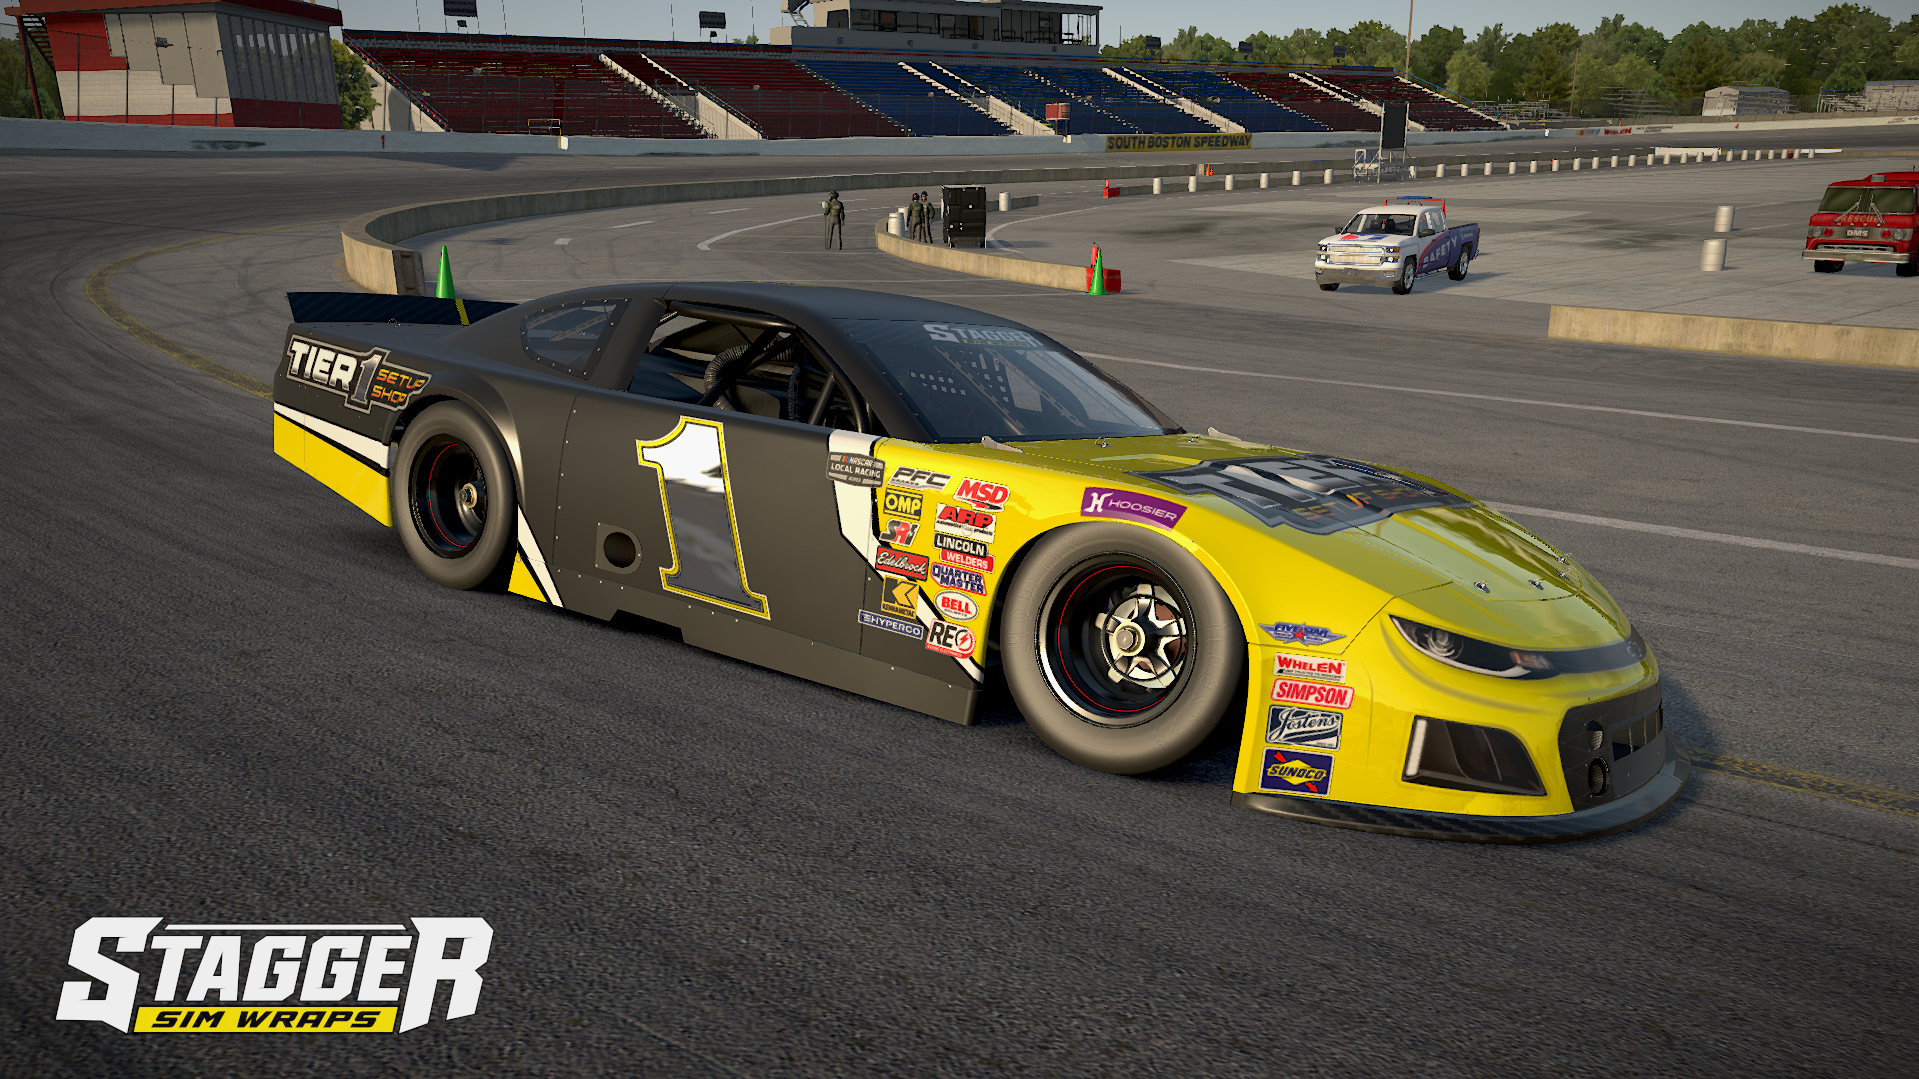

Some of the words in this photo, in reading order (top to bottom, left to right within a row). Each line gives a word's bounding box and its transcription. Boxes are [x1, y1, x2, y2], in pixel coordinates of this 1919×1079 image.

[380, 134, 386, 150] 1
[1107, 136, 1145, 150] SOUTH
[1149, 135, 1191, 149] BOSTON
[1193, 134, 1252, 149] SPEEDWAY
[1840, 214, 1879, 223] RESCUE
[1846, 229, 1869, 237] DMS
[1422, 235, 1458, 269] SAFETY
[923, 324, 1044, 348] STAGGER
[291, 340, 358, 391] TIER
[351, 354, 382, 405] 1
[376, 368, 426, 390] SETUP
[371, 384, 408, 404] SHOP
[830, 462, 853, 474] LOCAL
[854, 466, 881, 479] RACING
[848, 456, 874, 467] NASCAR
[892, 466, 952, 487] PFC
[956, 479, 1009, 504] MSD
[885, 494, 922, 514] OMP
[1108, 498, 1178, 522] HOOSIER
[635, 415, 771, 621] 1
[937, 505, 994, 528] ARP
[936, 534, 986, 557] LINCOLN
[877, 551, 928, 576] Edelbrock
[946, 551, 989, 570] WELDERS
[931, 564, 984, 583] QUARTER
[939, 575, 985, 595] MASTER
[941, 596, 972, 615] BELL
[869, 616, 921, 637] HYPERCO
[1276, 655, 1343, 675] WHELEN
[1276, 681, 1348, 706] SIMPSON
[1267, 706, 1339, 741] Jostens
[1268, 765, 1326, 781] SUNOCO
